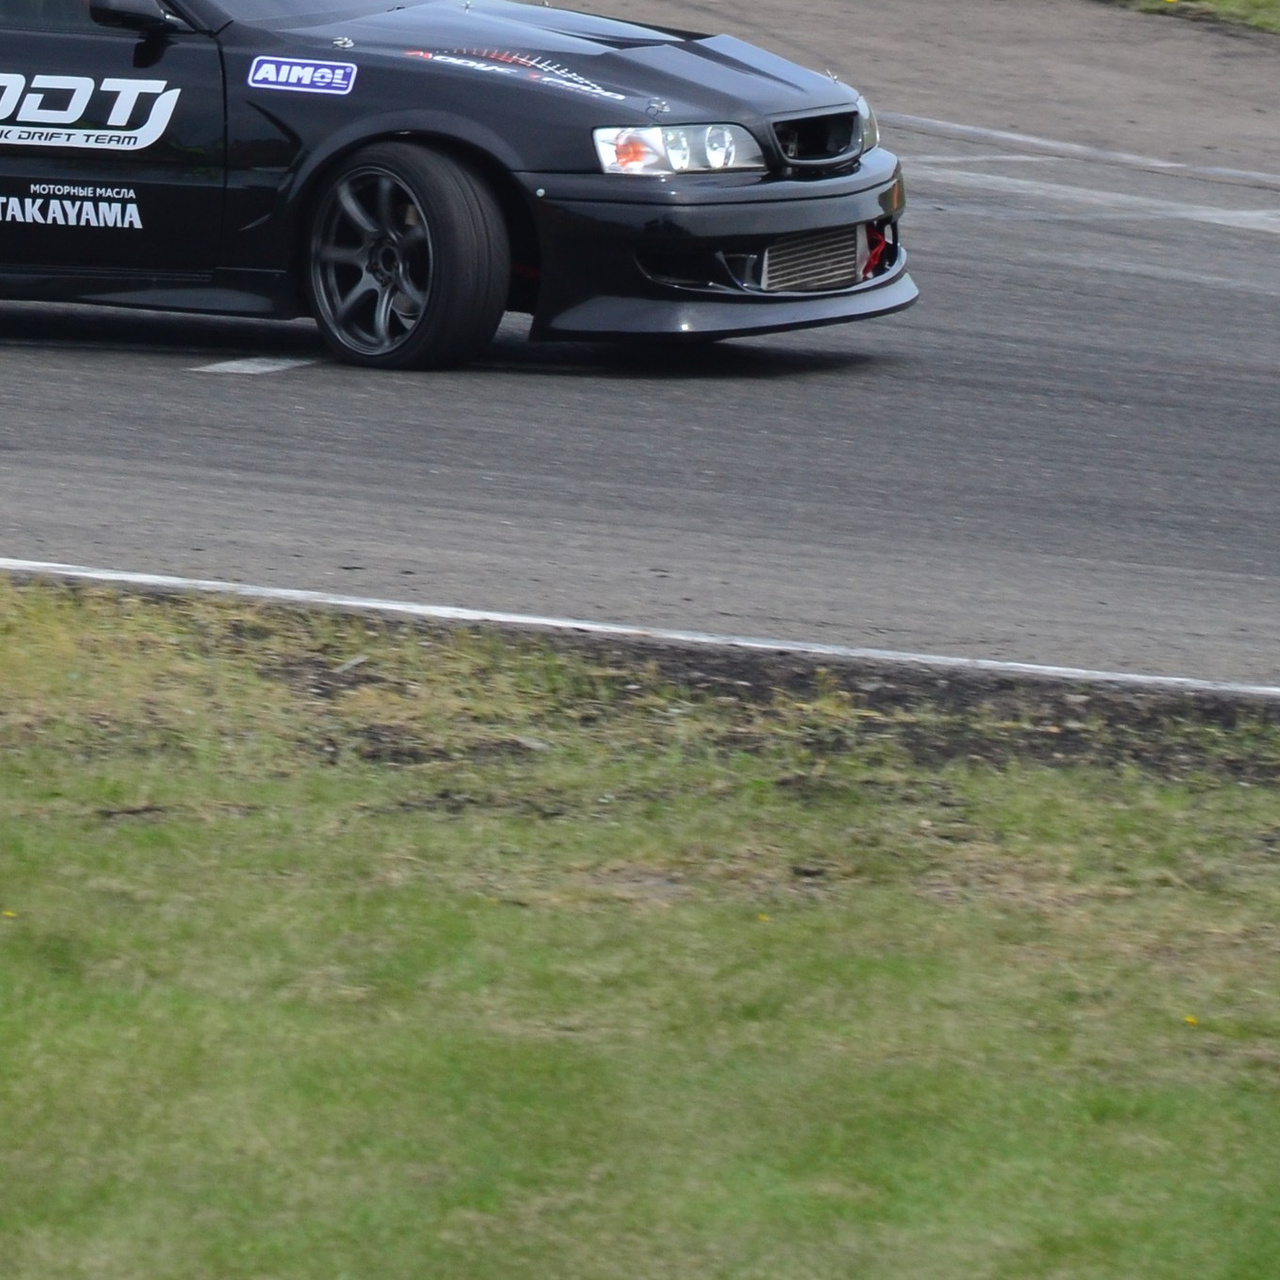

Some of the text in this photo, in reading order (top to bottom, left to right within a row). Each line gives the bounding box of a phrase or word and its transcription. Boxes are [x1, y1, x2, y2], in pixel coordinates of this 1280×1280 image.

[253, 63, 348, 87] AIMOL
[17, 130, 76, 143] DRIFT
[83, 134, 138, 146] TEAM
[30, 184, 136, 199] МОТОРНЫЕ МАСЛА
